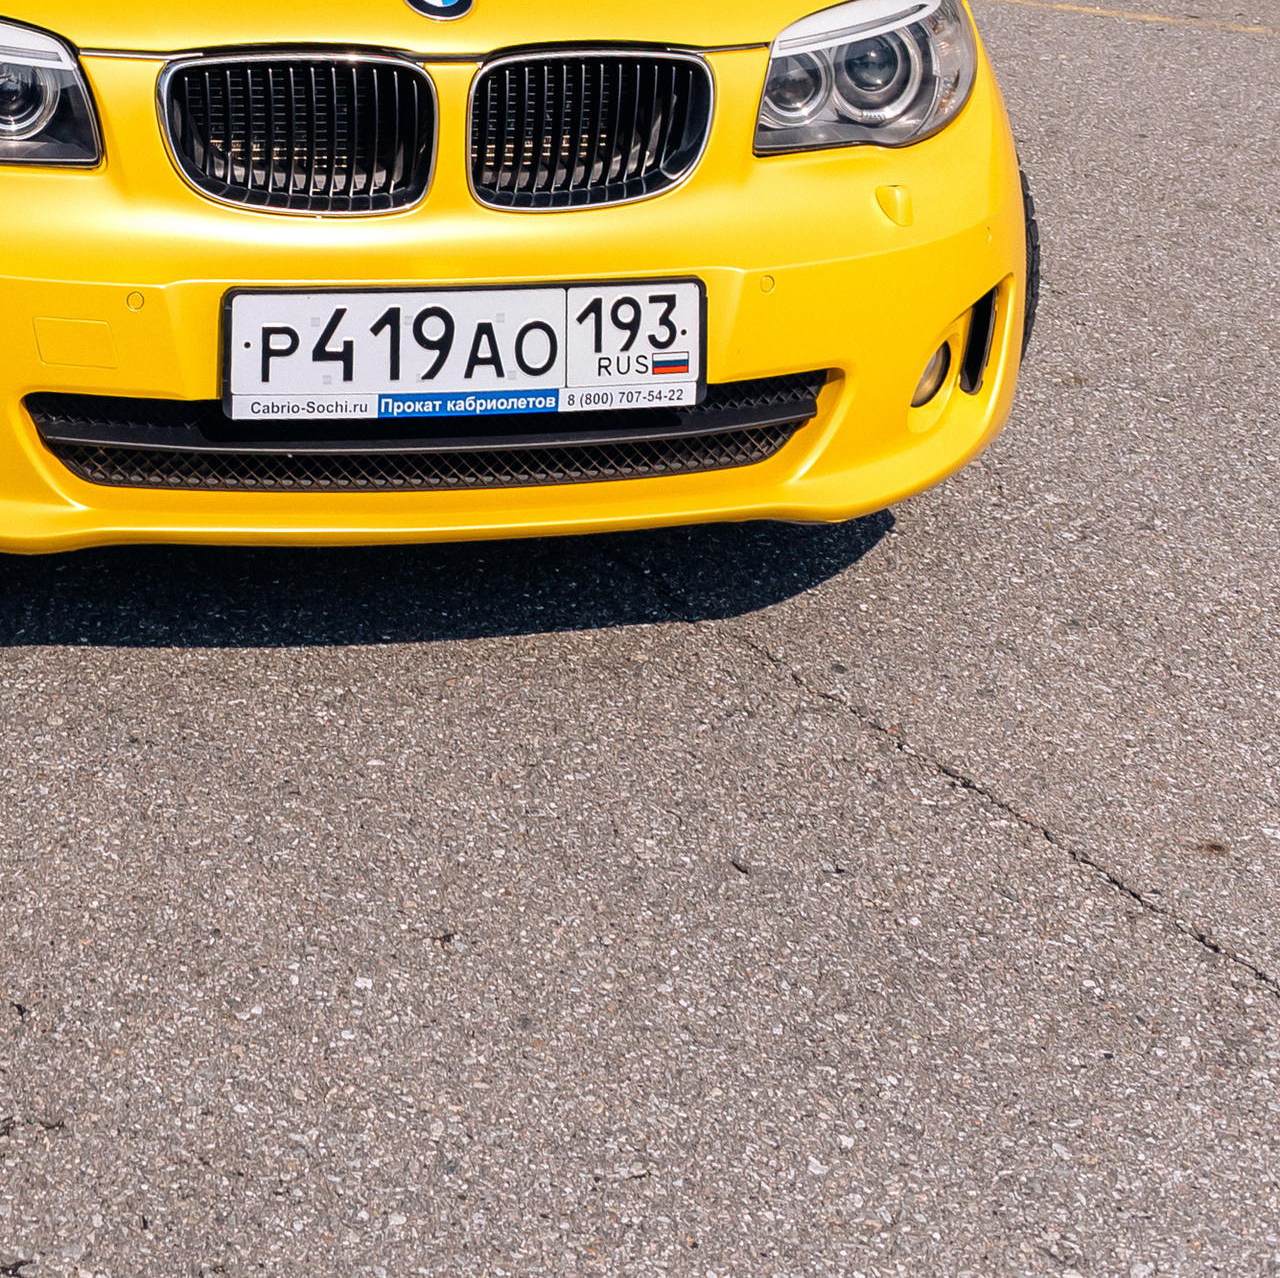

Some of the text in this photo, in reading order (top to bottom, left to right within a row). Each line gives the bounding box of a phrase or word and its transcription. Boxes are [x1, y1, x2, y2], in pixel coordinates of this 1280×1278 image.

[575, 294, 678, 354] 193
[597, 354, 650, 377] RUS
[249, 400, 369, 415] Cabrio-Sochi.ru
[379, 395, 557, 416] Прокат кабриолетов
[566, 388, 685, 408] 8 (800) 707-54-22
